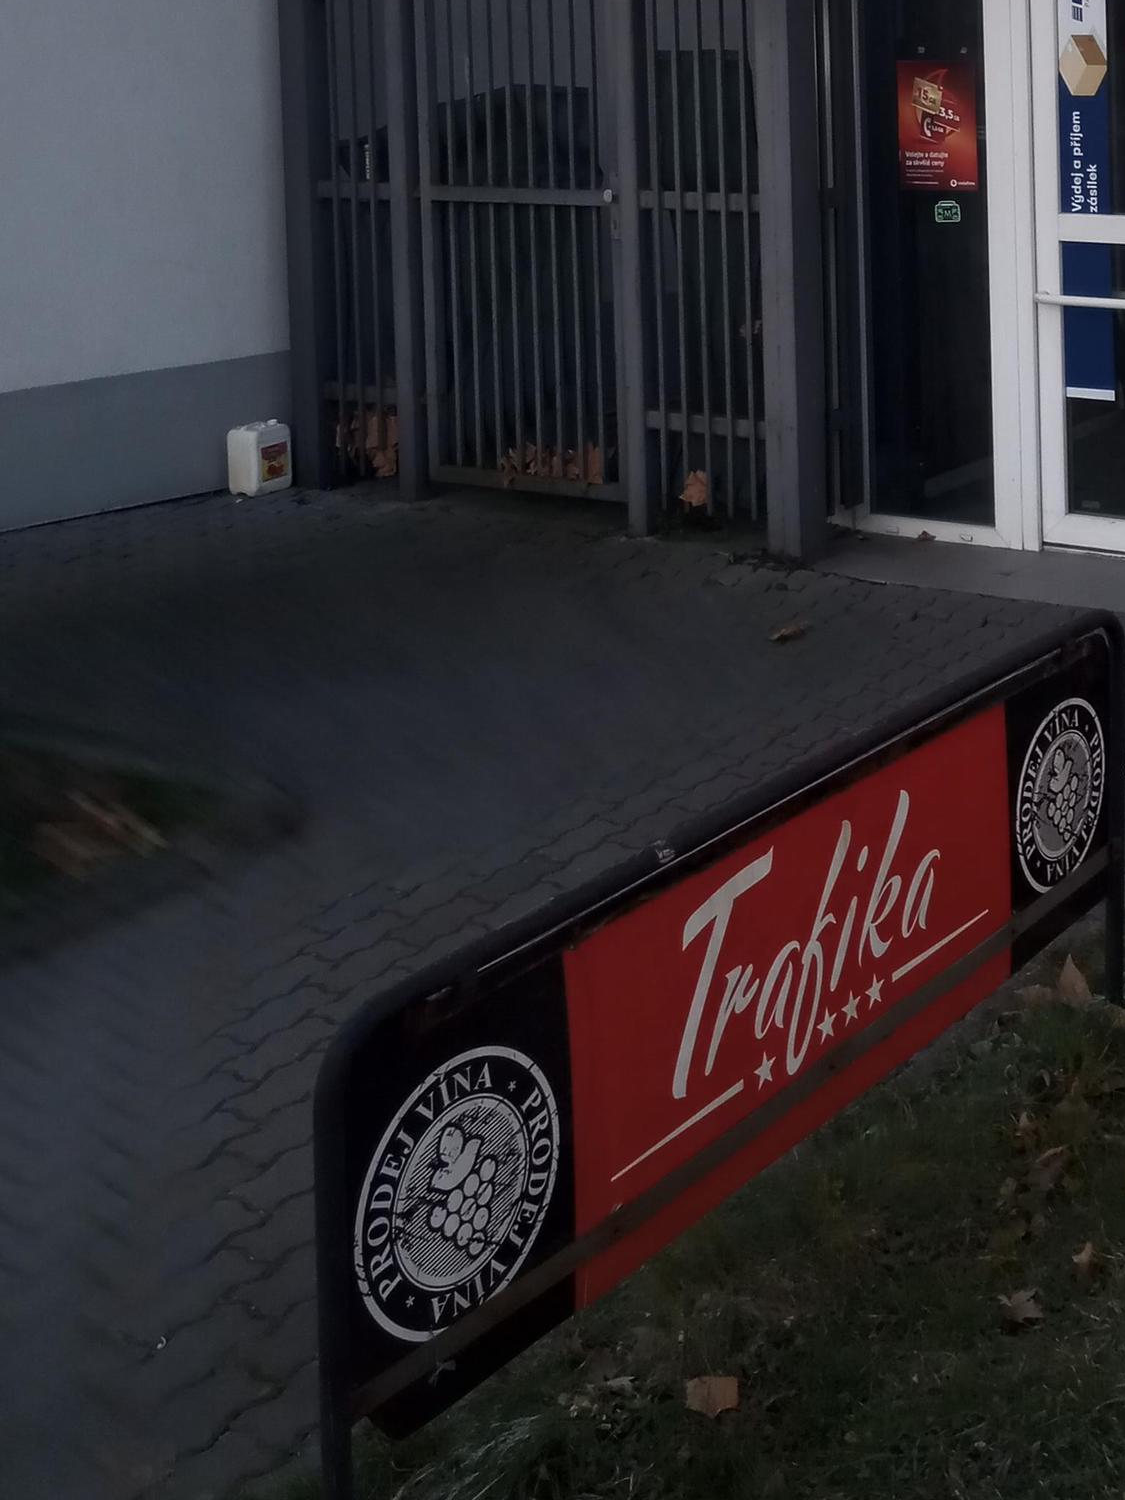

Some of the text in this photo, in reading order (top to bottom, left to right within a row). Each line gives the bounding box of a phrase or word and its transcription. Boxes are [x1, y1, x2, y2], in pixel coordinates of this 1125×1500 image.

[1069, 111, 1084, 212] Výdej a příjem
[1086, 164, 1098, 213] zásilek
[1021, 748, 1044, 860] PRODEJ
[1081, 732, 1102, 840] PRODEJ
[671, 790, 941, 1100] Trafika
[367, 1062, 494, 1301] PRODEJ VÍNA
[508, 1087, 551, 1250] PRODEJ
